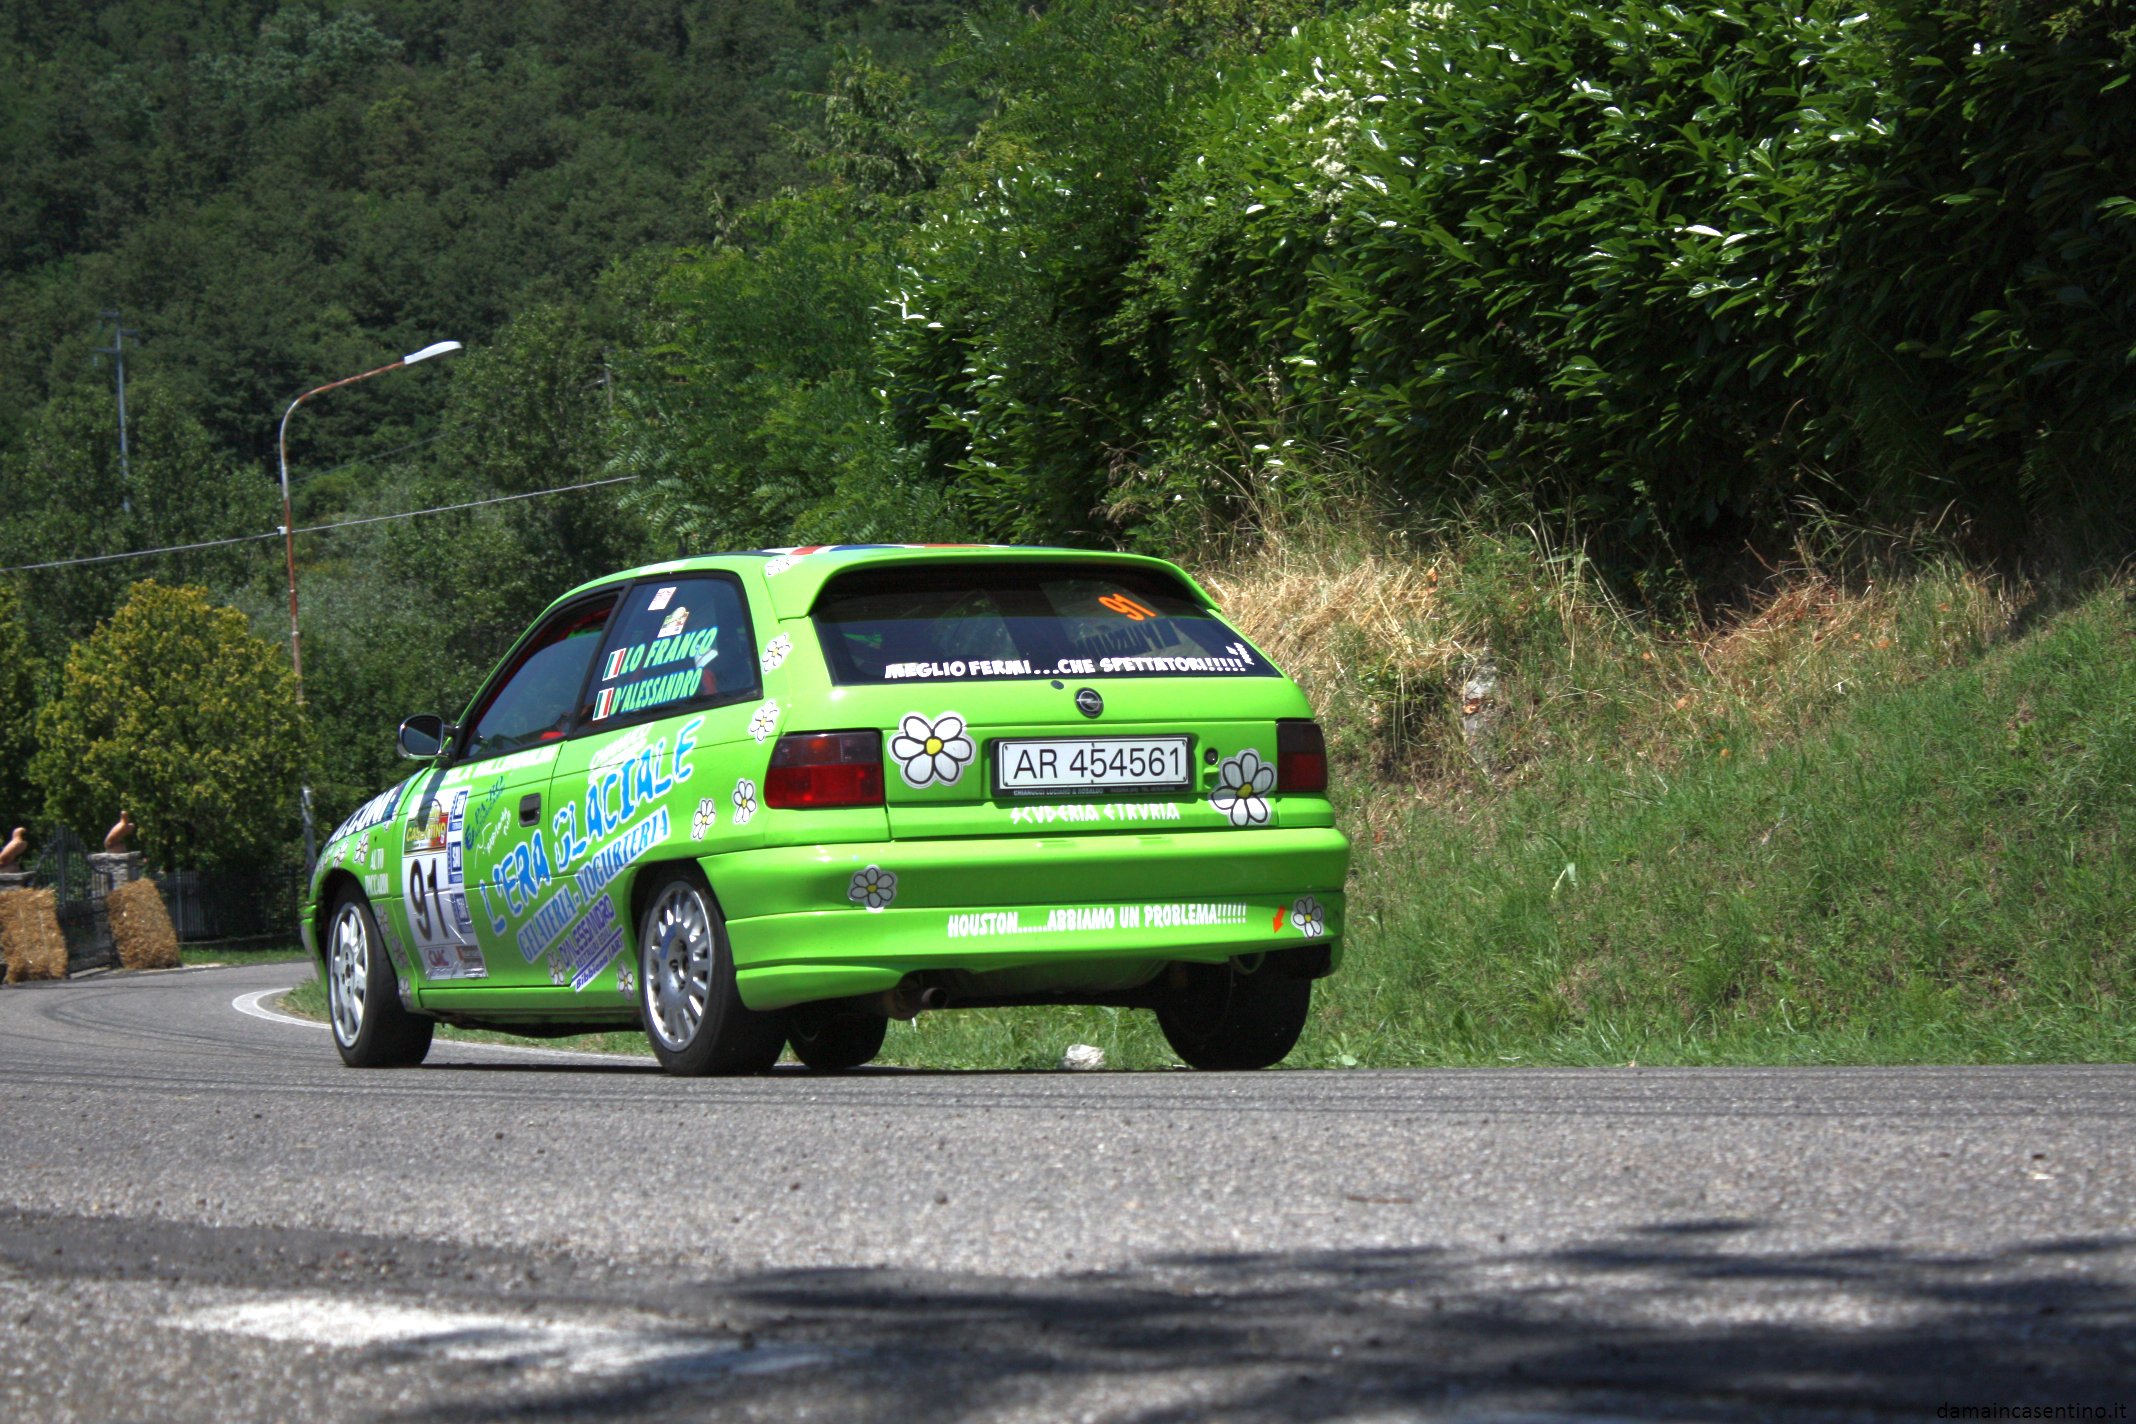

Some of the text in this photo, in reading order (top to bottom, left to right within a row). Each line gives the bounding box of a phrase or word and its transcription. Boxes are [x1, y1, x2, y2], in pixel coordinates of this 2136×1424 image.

[1098, 592, 1157, 622] 91
[618, 626, 719, 675] LO FRANCO
[884, 660, 966, 679] MEGLIO
[609, 667, 703, 717] D'ALESSANDRO
[1012, 746, 1180, 780] AR 454561
[480, 830, 551, 935] L'ERA
[553, 716, 705, 873] GLACIALE
[410, 857, 449, 943] 91
[518, 885, 577, 962] GELATERIA
[575, 809, 669, 901] YOGURTERIA
[1119, 905, 1140, 929] UN
